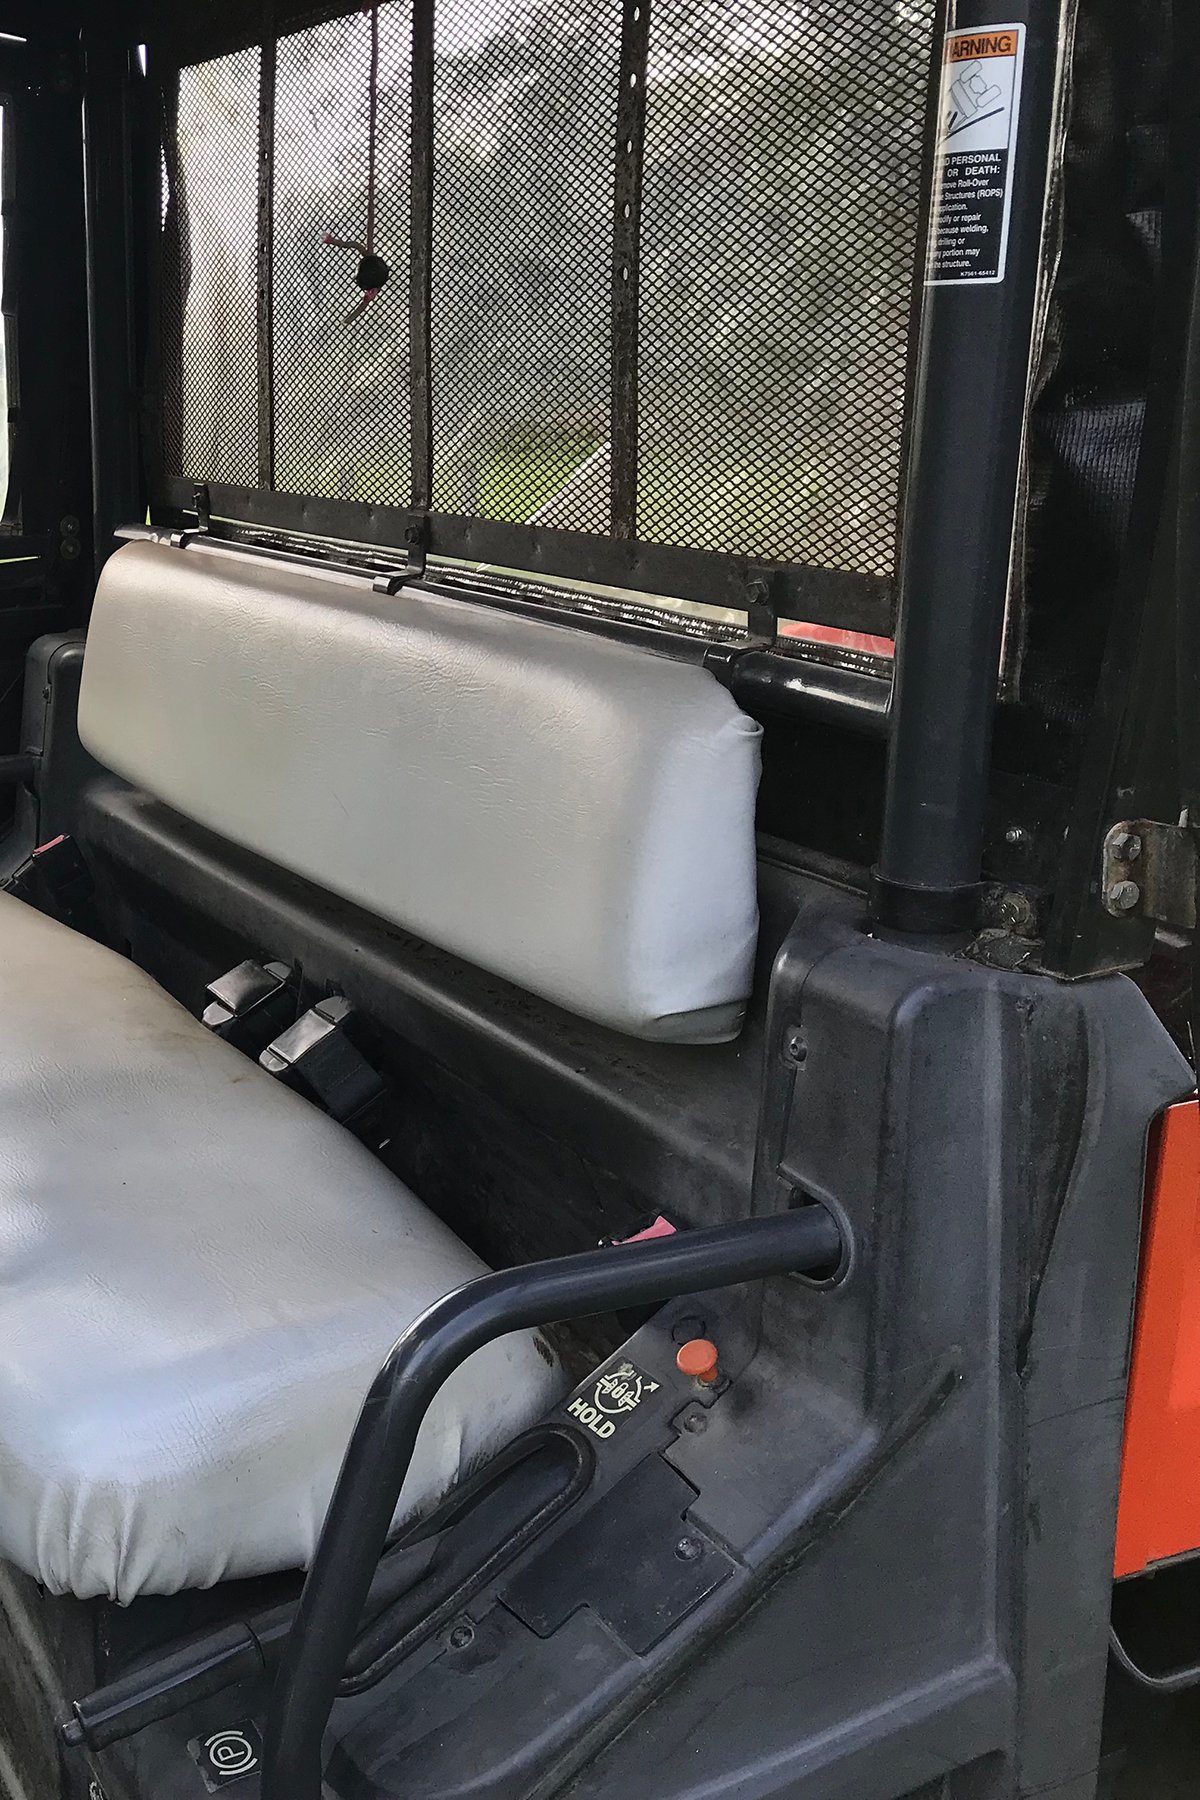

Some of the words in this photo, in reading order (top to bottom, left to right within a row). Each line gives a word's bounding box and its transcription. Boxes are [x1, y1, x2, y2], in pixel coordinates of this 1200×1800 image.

[951, 153, 1002, 165] PERSONAL
[947, 168, 959, 177] OR
[965, 165, 1001, 176] DEATH:
[958, 178, 990, 188] Roll-Over
[977, 188, 1004, 200] (ROPS)
[961, 212, 982, 223] repair
[960, 224, 989, 234] welding,
[957, 237, 966, 245] or
[942, 248, 964, 259] portion
[964, 248, 981, 257] may
[942, 259, 972, 268] structure.
[567, 1397, 616, 1439] HOLD
